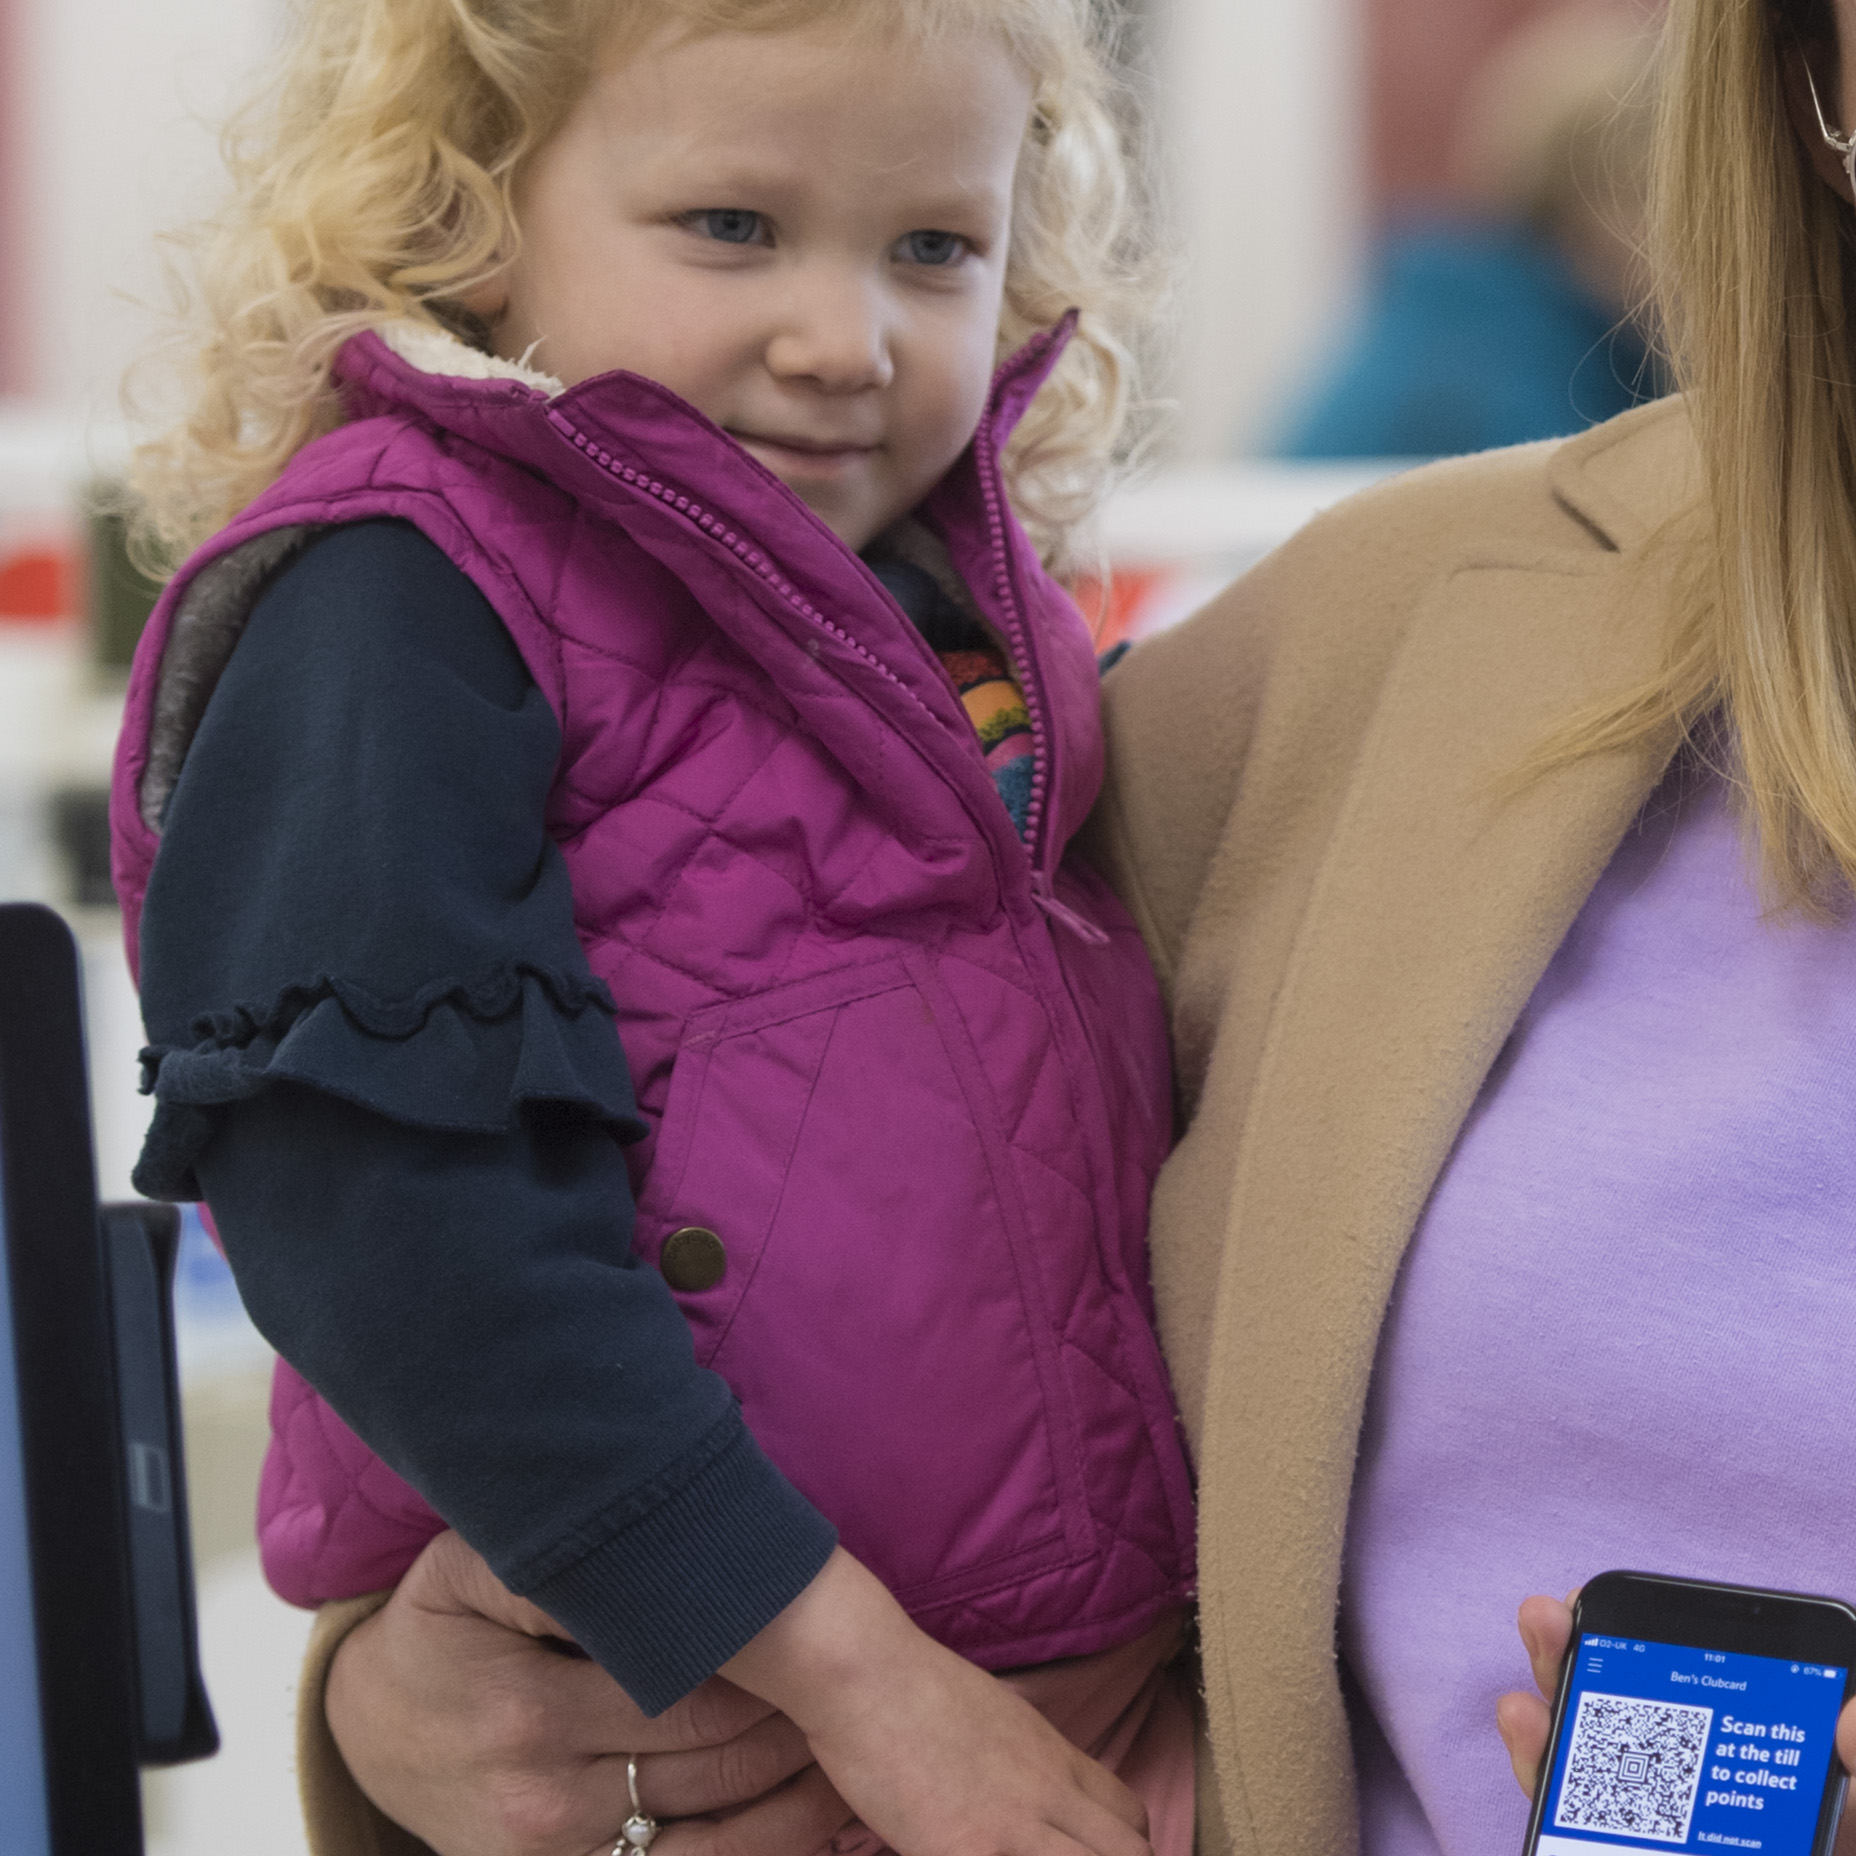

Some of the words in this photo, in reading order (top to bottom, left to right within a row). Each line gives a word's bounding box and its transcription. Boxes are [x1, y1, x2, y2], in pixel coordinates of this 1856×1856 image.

[1633, 1644, 1646, 1653] 4G
[1704, 1653, 1726, 1663] 11:01
[1670, 1671, 1698, 1685] Ben's
[1701, 1676, 1747, 1692] Clubcard
[1720, 1716, 1766, 1737] Scan
[1771, 1723, 1806, 1743] this
[1716, 1743, 1736, 1758] at
[1740, 1744, 1770, 1762] the
[1775, 1749, 1801, 1766] till
[1712, 1765, 1730, 1781] to
[1735, 1769, 1798, 1790] collect
[1705, 1790, 1764, 1810] points
[1698, 1831, 1706, 1842] It
[1707, 1833, 1722, 1844] did
[1723, 1836, 1740, 1846] not
[1741, 1839, 1762, 1849] scan
